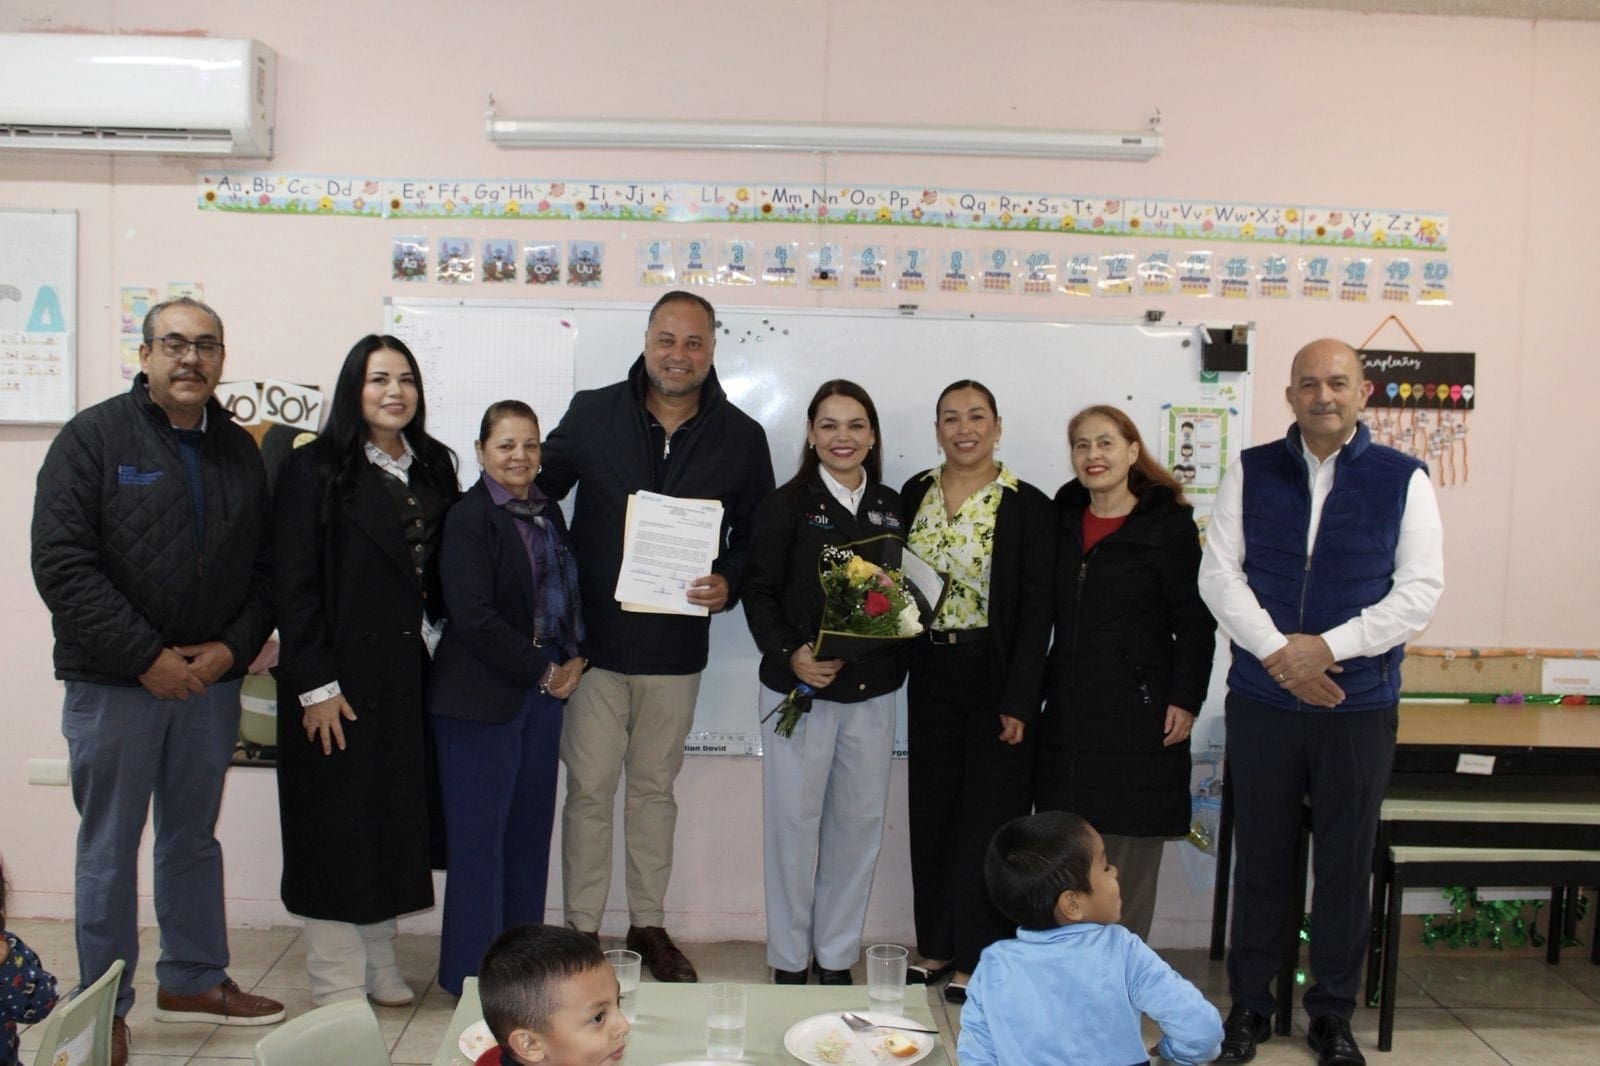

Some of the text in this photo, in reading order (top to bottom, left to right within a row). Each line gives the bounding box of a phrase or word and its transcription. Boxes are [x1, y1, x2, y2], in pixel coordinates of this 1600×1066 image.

[217, 177, 242, 192] Aa
[253, 177, 275, 192] Bb
[288, 179, 309, 195] Cc
[327, 180, 351, 196] Dd
[403, 183, 425, 199] Ee
[439, 183, 459, 199] Ff
[475, 184, 499, 202] Gg
[510, 185, 533, 199] Hh
[590, 185, 606, 200] Ii
[625, 185, 645, 204] Jj
[772, 189, 801, 203] Mm
[812, 189, 838, 204] Nn
[850, 190, 875, 205] Oo
[890, 191, 909, 209] Pp
[960, 194, 986, 213] Qq
[1000, 196, 1021, 213] Rr
[1037, 198, 1058, 214] Ss
[1072, 200, 1093, 215] Tt
[1144, 203, 1169, 219] Uu
[1181, 205, 1202, 220] Vv
[1215, 207, 1248, 223] Ww
[1257, 208, 1280, 224] Xx
[1350, 212, 1371, 232] Yy
[1388, 214, 1411, 231] Zz
[649, 242, 660, 260] 1
[689, 242, 701, 260] 2
[731, 245, 743, 263] 3
[775, 246, 787, 265] 4
[820, 246, 832, 265] 5
[862, 248, 875, 266] 6
[908, 250, 918, 269] 7
[951, 251, 962, 270] 8
[992, 249, 1006, 269] 9
[1026, 254, 1049, 272] 10
[1264, 256, 1286, 275] 16
[1309, 256, 1328, 276] 17
[1346, 262, 1366, 280] 18
[1387, 261, 1409, 280] 19
[1424, 262, 1448, 280] 20
[266, 385, 320, 424] SOY
